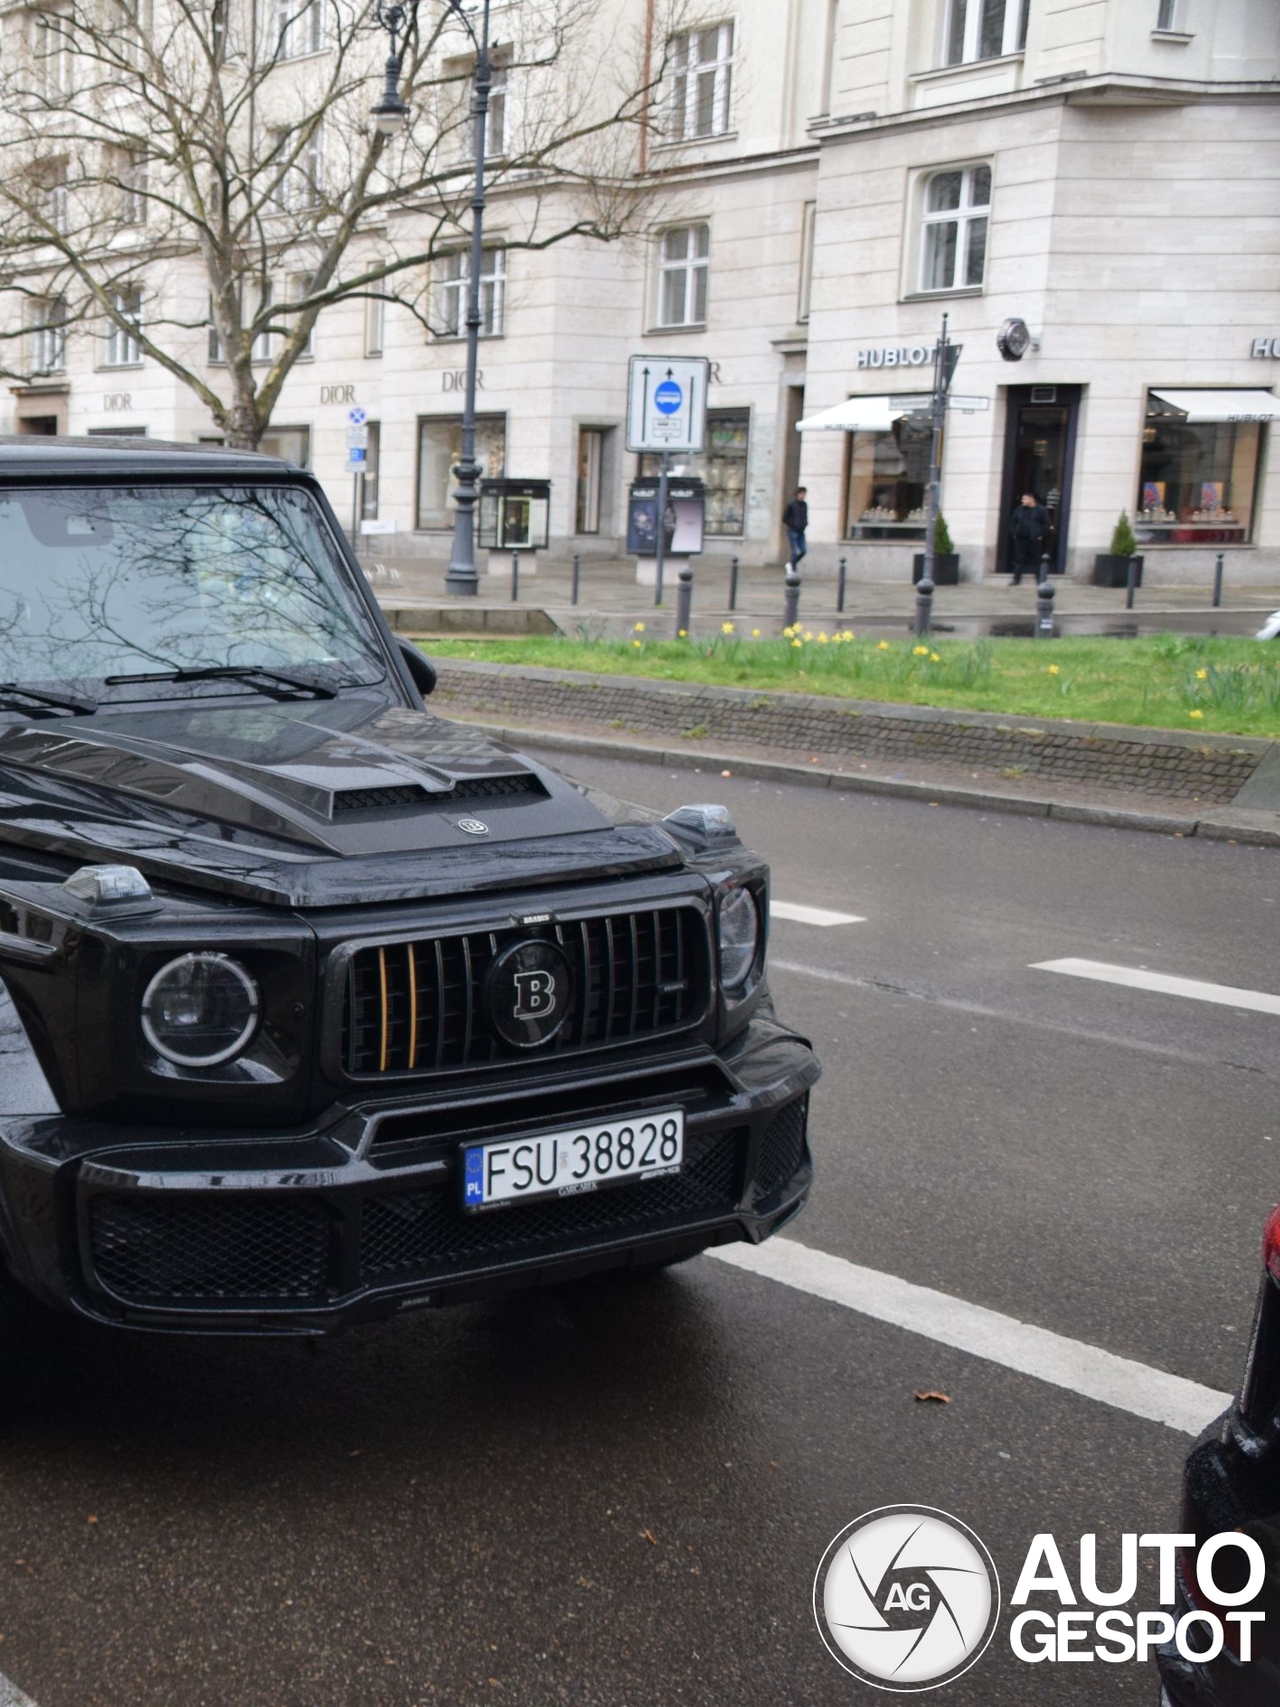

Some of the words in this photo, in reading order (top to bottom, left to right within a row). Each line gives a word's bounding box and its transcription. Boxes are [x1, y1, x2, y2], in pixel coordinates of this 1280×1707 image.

[856, 346, 937, 369] HUBLOT
[103, 393, 133, 411] DIOR
[320, 385, 356, 405] DIOR
[1226, 413, 1273, 423] HUBLOT
[513, 969, 556, 1021] B
[487, 1139, 558, 1196] FSU
[572, 1118, 678, 1179] 38828
[467, 1182, 482, 1196] PL
